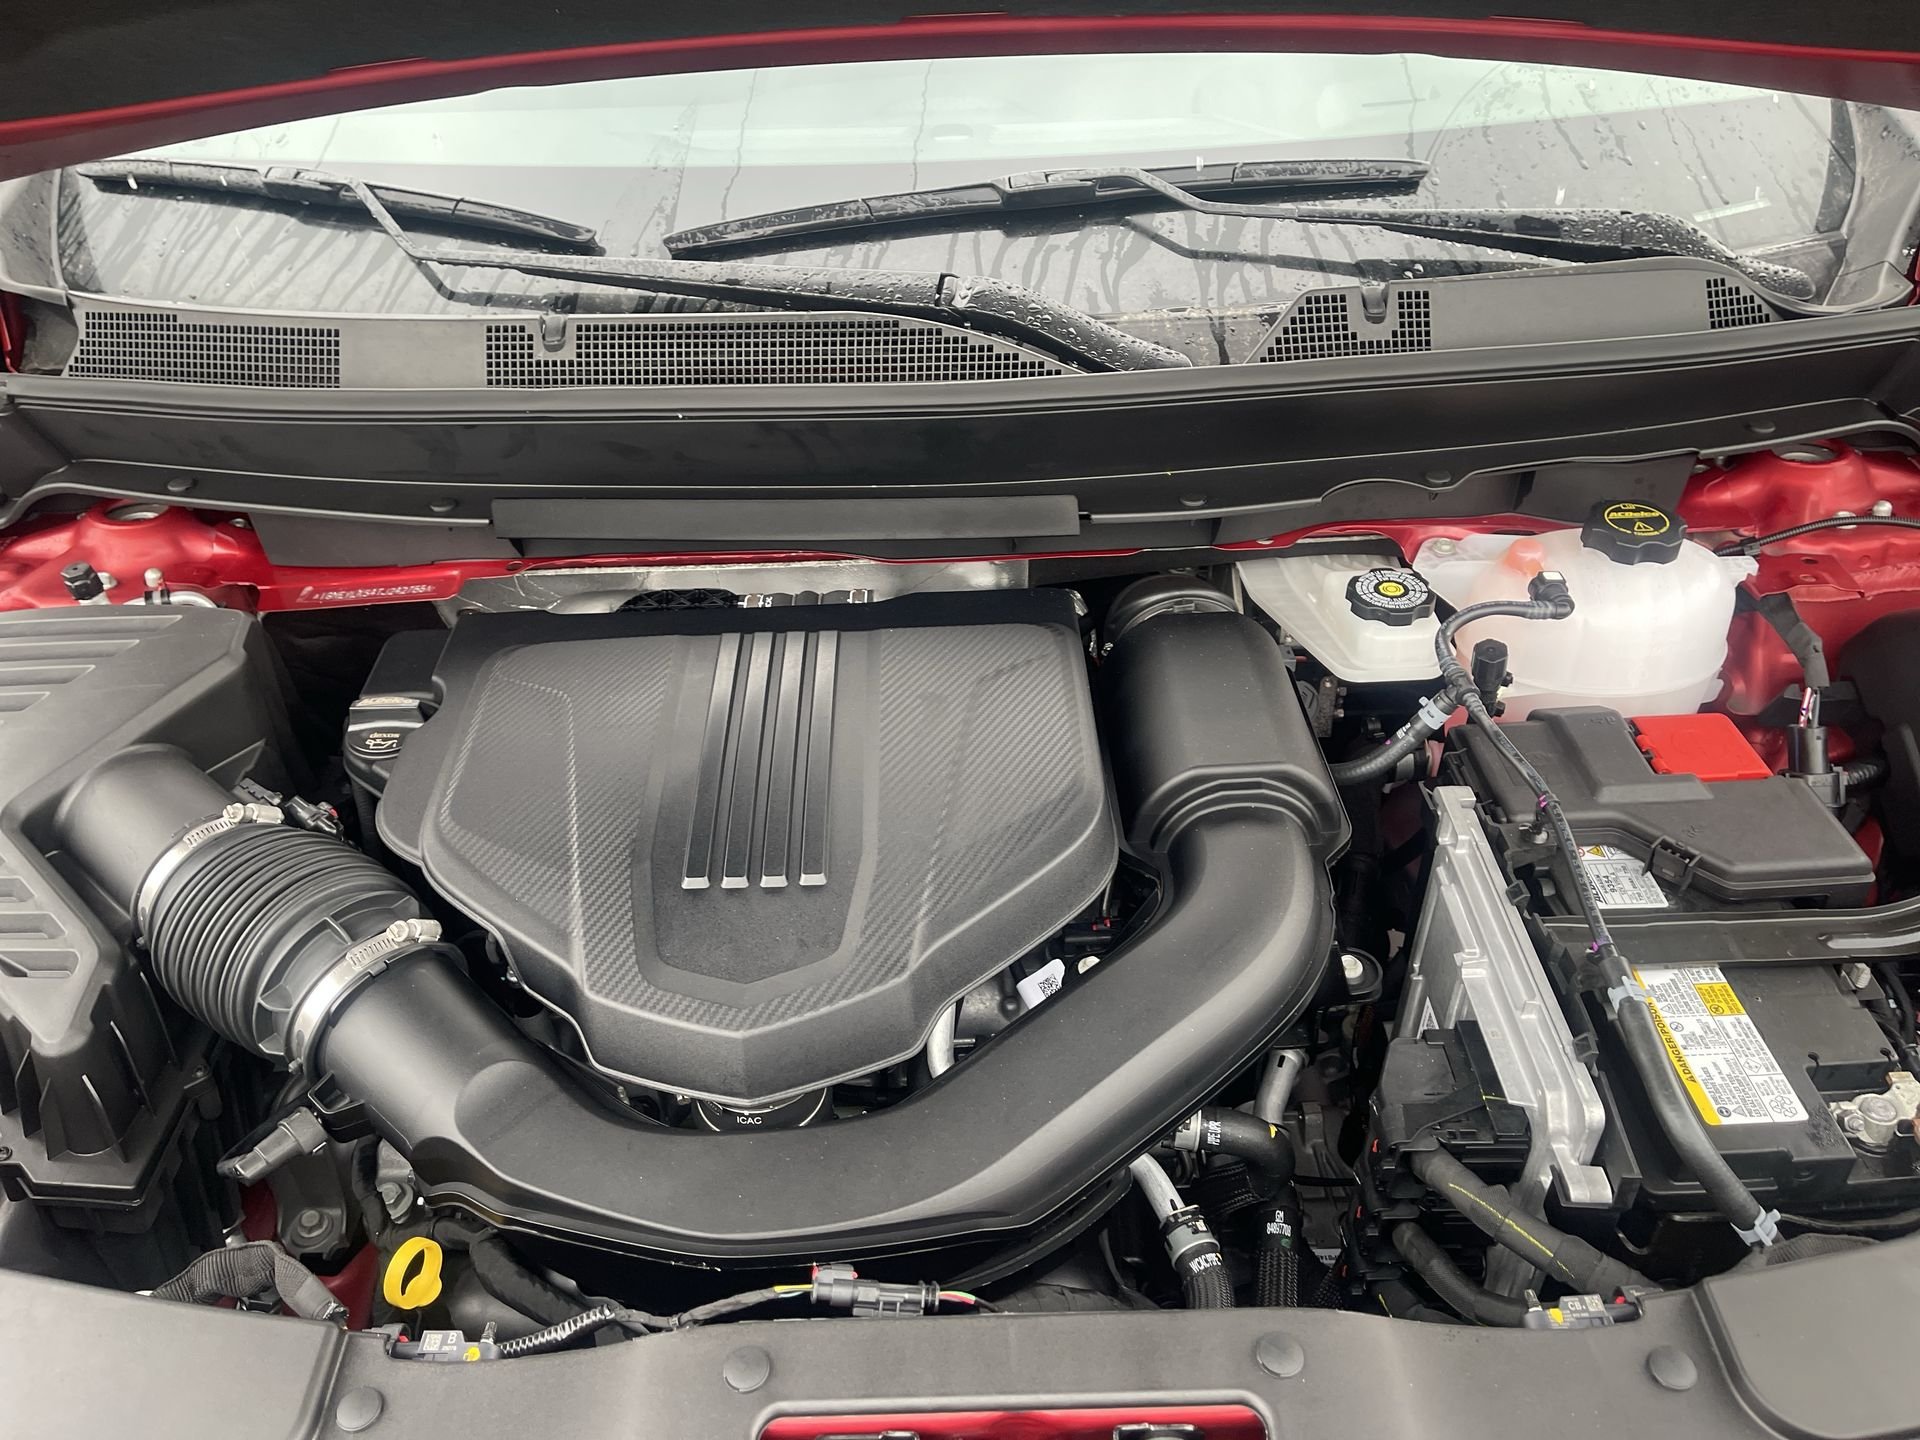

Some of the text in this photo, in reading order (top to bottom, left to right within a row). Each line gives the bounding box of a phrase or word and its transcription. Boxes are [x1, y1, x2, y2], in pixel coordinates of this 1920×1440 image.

[1608, 511, 1660, 519] ACDelco
[736, 1116, 762, 1125] ICAC
[1275, 1210, 1284, 1222] GM
[448, 1332, 457, 1344] B
